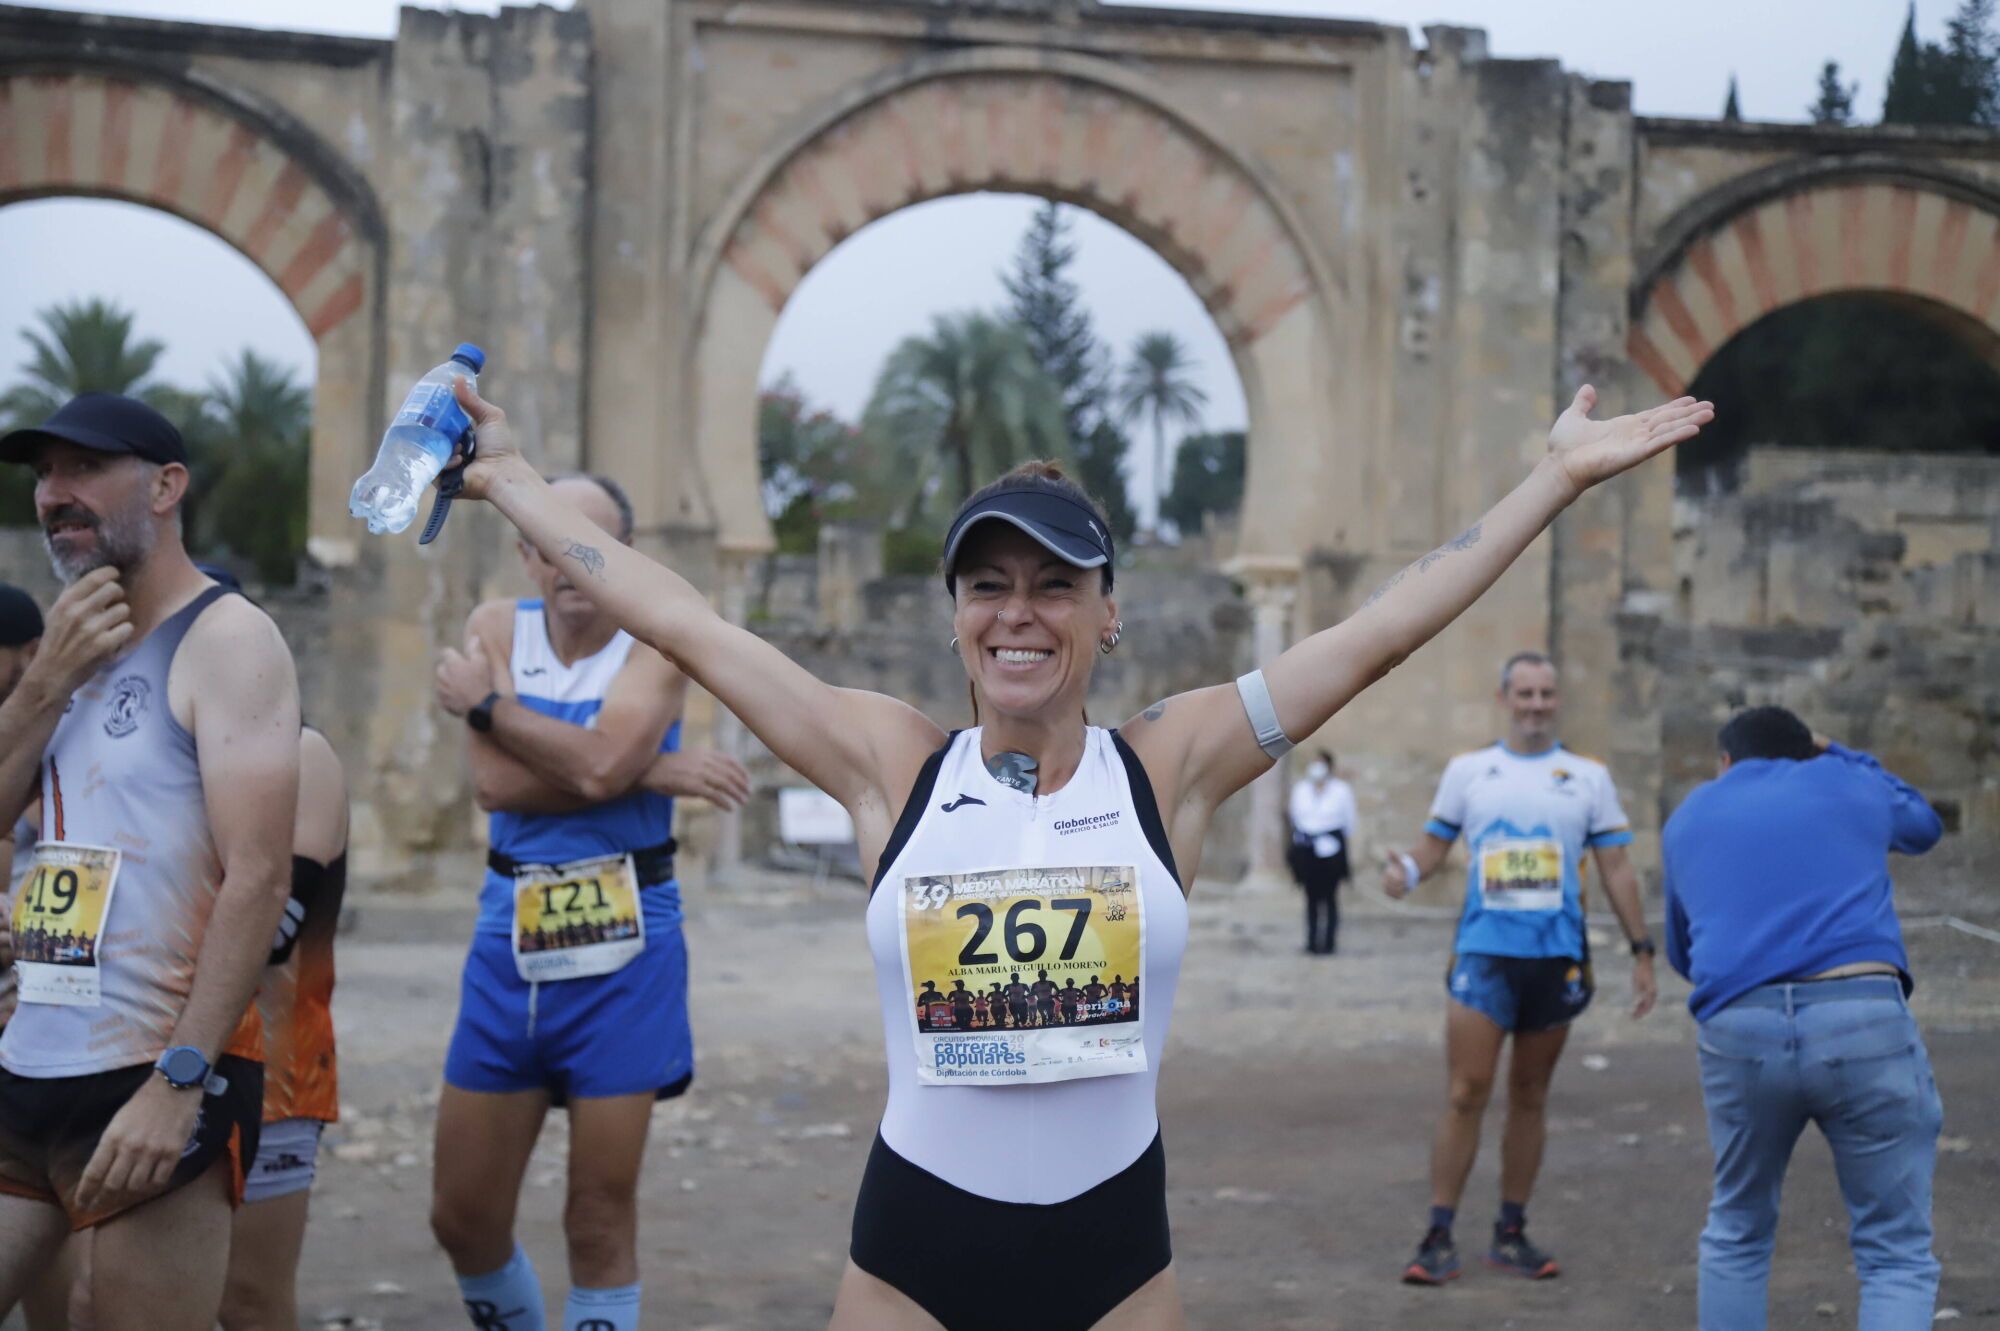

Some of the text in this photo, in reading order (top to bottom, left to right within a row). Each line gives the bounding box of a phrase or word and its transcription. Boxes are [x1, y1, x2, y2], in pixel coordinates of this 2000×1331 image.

[1054, 810, 1120, 830] Globalcenter
[1060, 825, 1091, 836] EJERCICIO
[1098, 819, 1119, 829] SALUD
[539, 878, 610, 916] 121
[912, 884, 950, 911] 39
[953, 880, 1003, 895] MEDIA
[956, 897, 1092, 966] 267
[947, 960, 1108, 977] ALBA MARIA REGUILLO MORENO
[1076, 1000, 1131, 1011] serizona
[933, 1035, 965, 1043] CIRCUITO
[966, 1034, 1008, 1042] PROVINCIAL
[934, 1042, 1009, 1055] carreras
[935, 1049, 1026, 1069] populares
[936, 1068, 1027, 1078] Diputación de Córdoba
